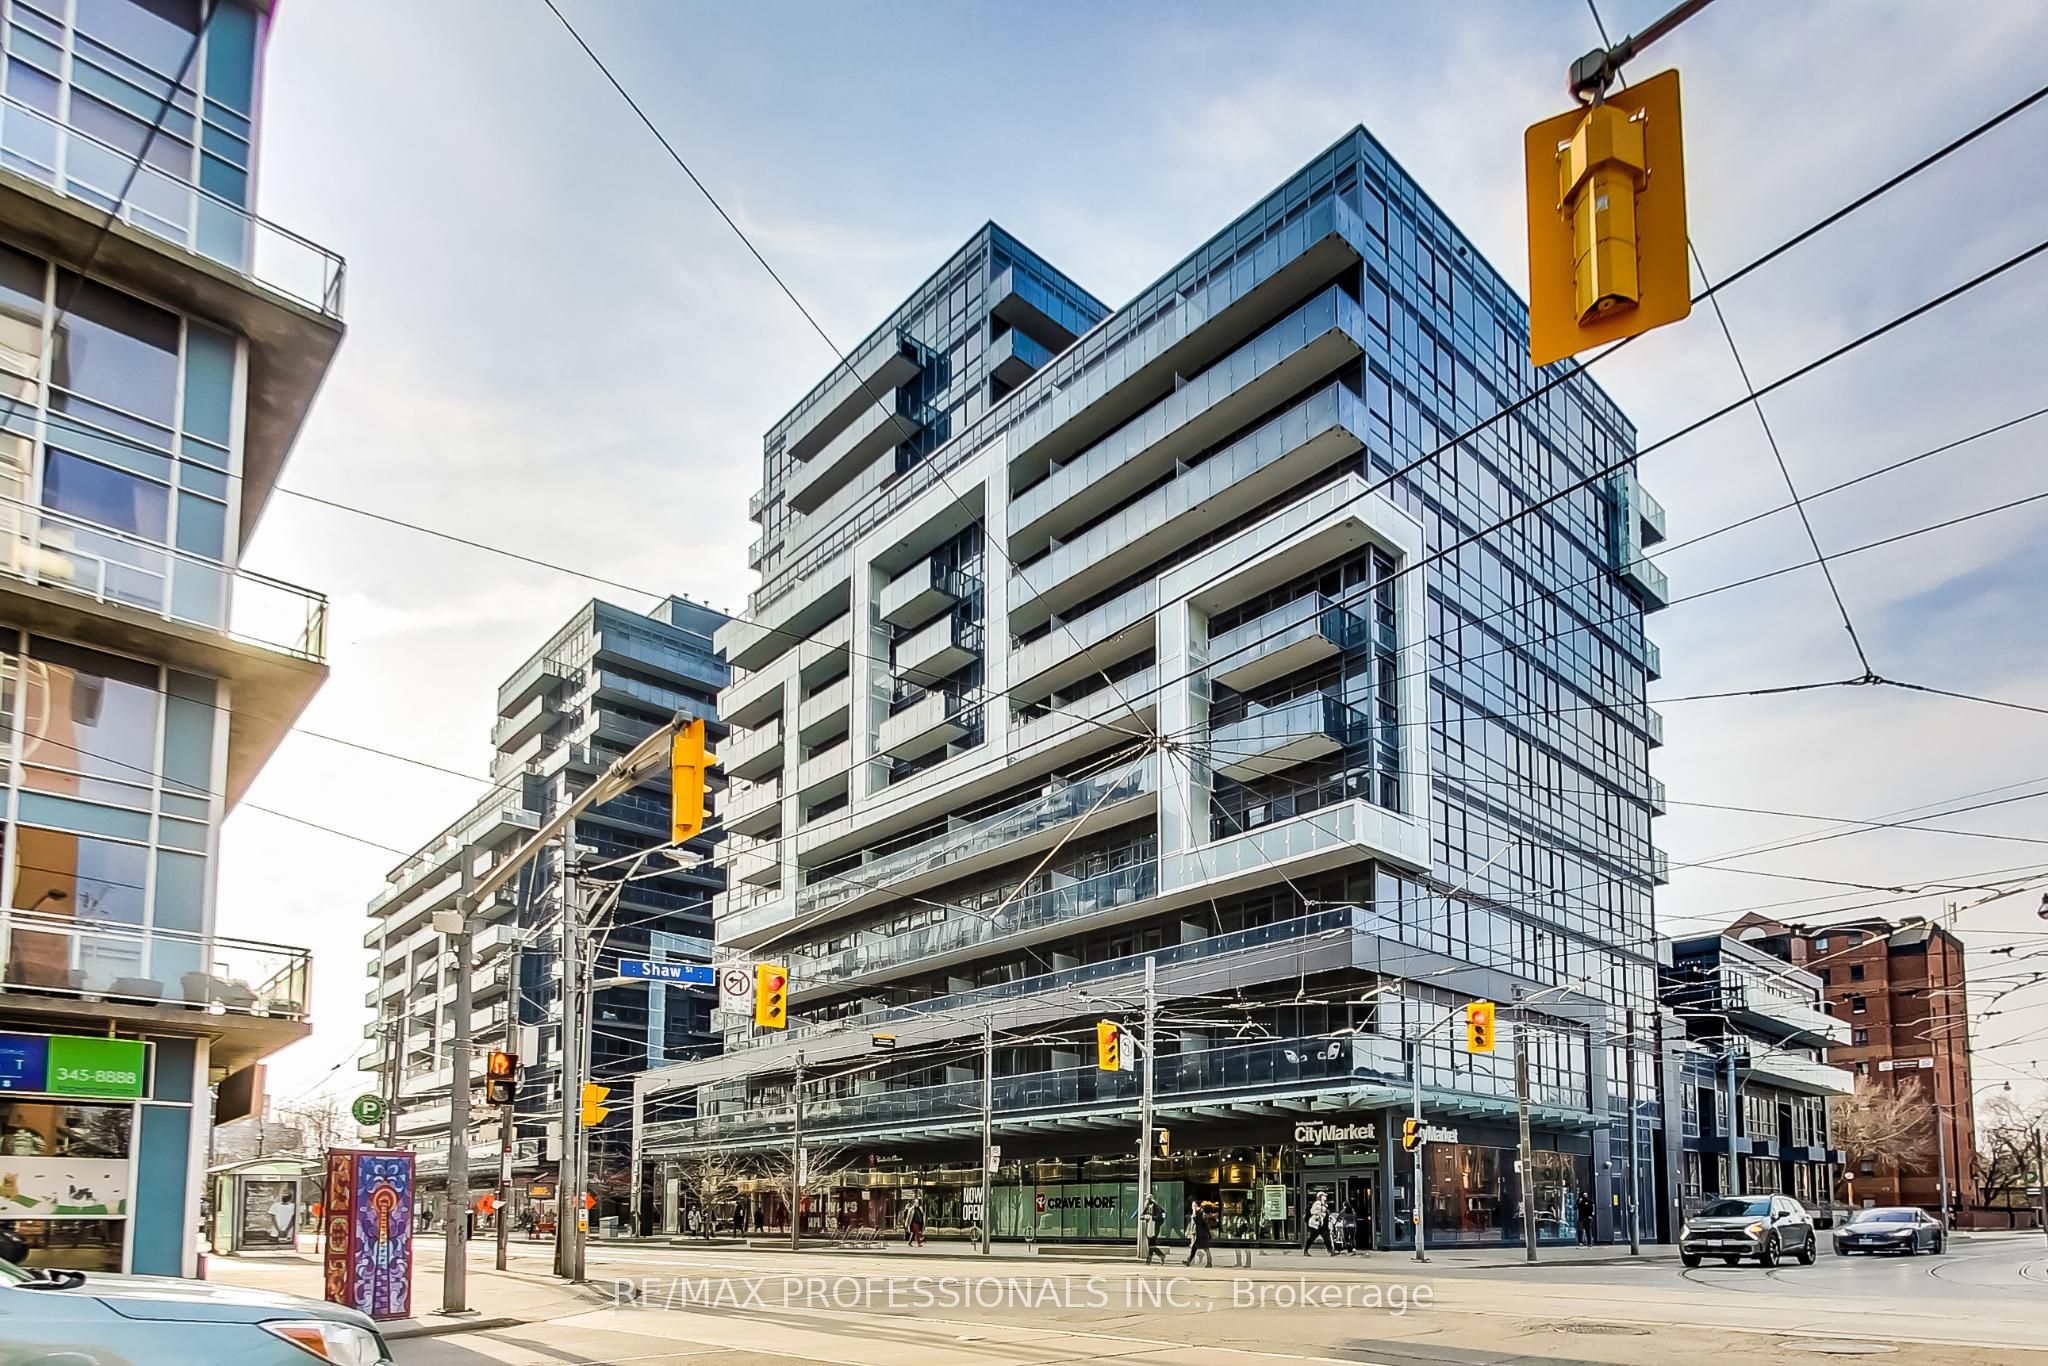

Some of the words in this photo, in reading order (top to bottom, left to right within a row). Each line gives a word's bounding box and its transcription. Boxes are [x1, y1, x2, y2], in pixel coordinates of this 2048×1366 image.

[642, 963, 681, 978] Shaw
[685, 966, 693, 974] St
[56, 1067, 136, 1085] 345-8888
[362, 1102, 378, 1115] P
[1294, 1123, 1376, 1146] CityMarket
[963, 1187, 983, 1204] NOW
[1047, 1196, 1082, 1210] CRAVE
[1084, 1195, 1117, 1209] MORE
[962, 1204, 983, 1221] OPEN
